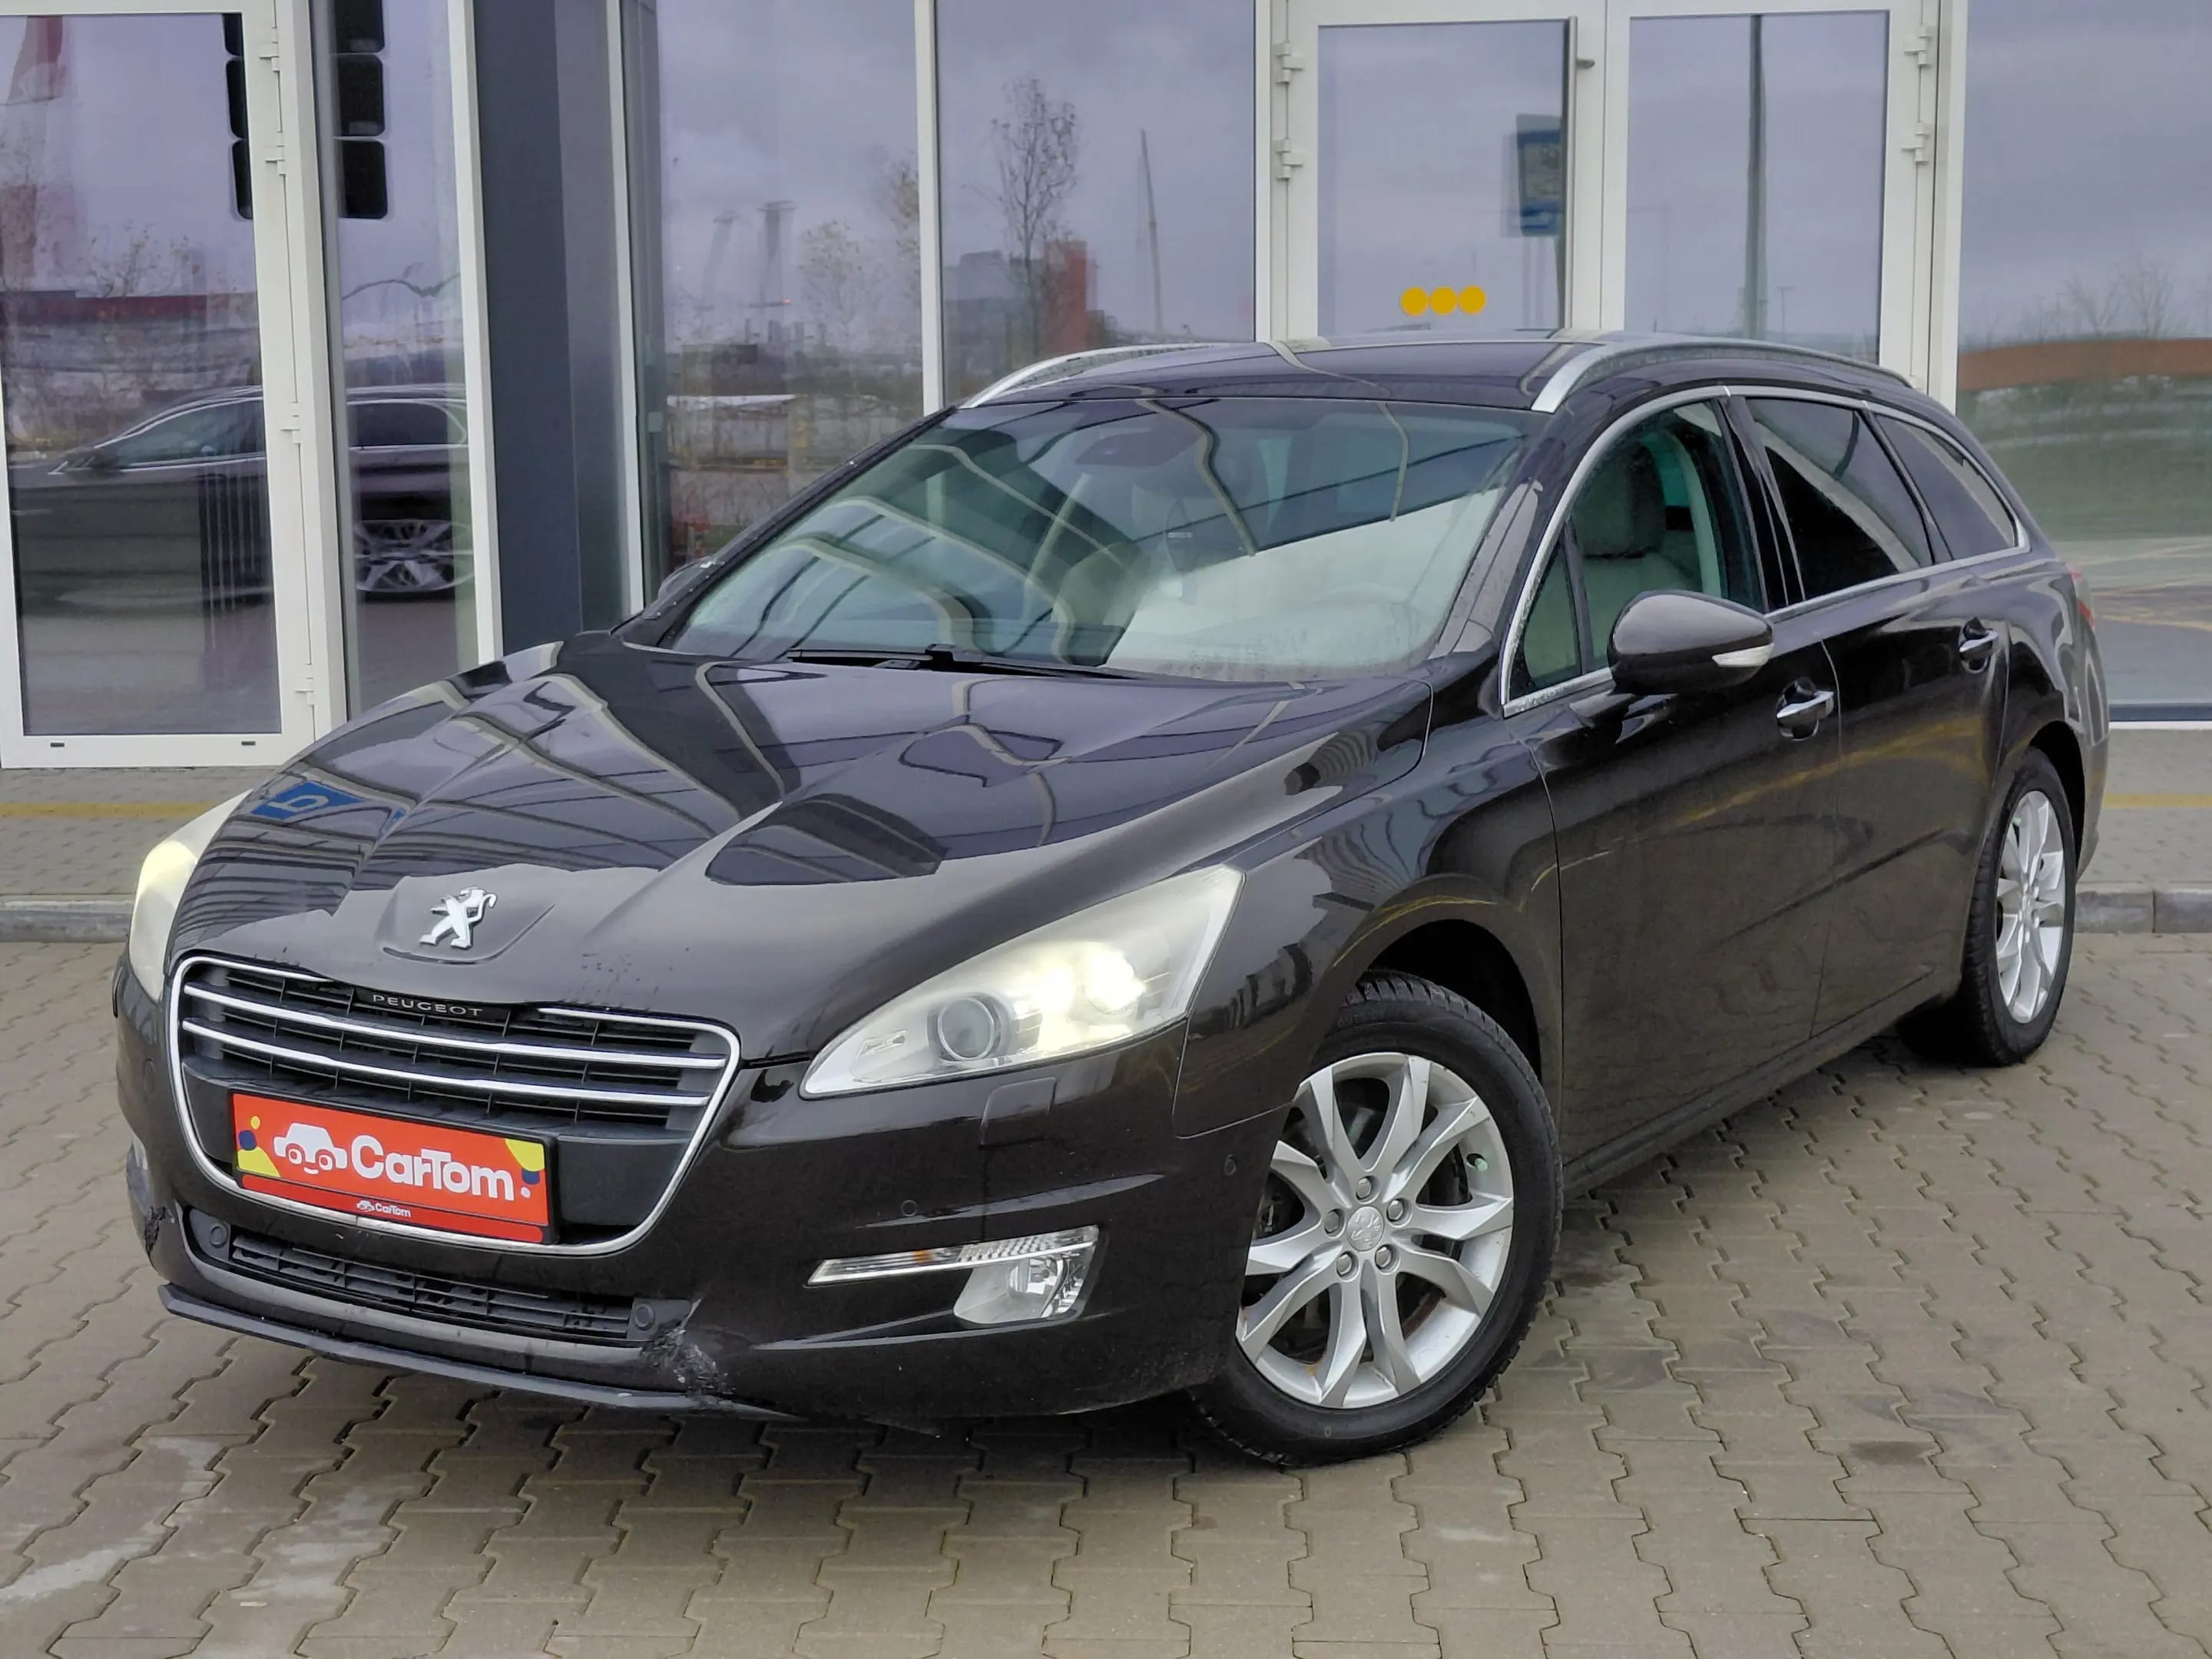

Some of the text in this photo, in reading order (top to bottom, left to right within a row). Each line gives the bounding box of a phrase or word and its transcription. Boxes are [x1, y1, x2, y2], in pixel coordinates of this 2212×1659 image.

[373, 995, 483, 1016] PEUGEOT
[351, 1134, 515, 1200] CarTom
[375, 1203, 411, 1217] CarTom
